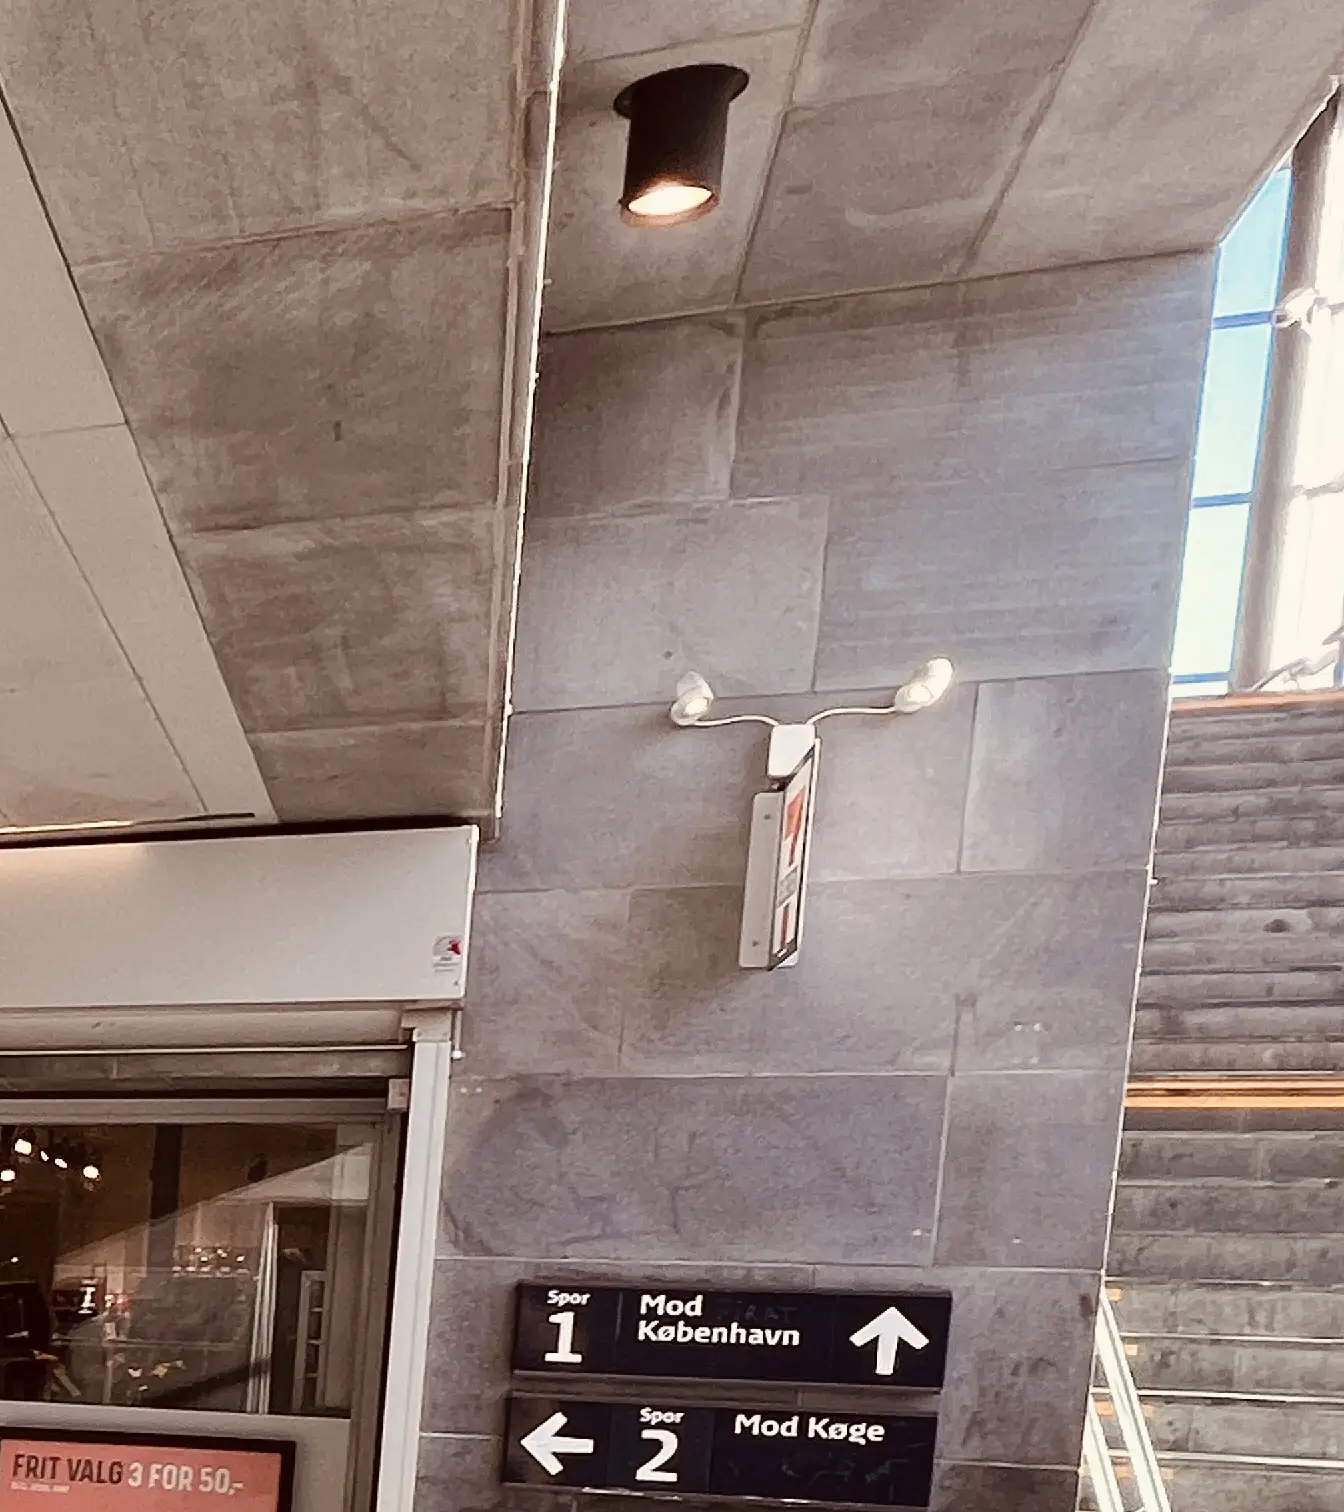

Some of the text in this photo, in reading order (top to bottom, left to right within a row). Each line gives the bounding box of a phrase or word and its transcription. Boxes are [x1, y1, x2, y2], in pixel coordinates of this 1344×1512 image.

[547, 1289, 591, 1307] Spor
[640, 1294, 703, 1318] Mod
[544, 1311, 582, 1363] 1
[638, 1319, 801, 1347] København
[639, 1407, 685, 1426] Spor
[734, 1414, 885, 1446] Mod Køge
[634, 1429, 680, 1484] 2
[12, 1453, 245, 1496] FRIT VALG 3 FOR 50,-
